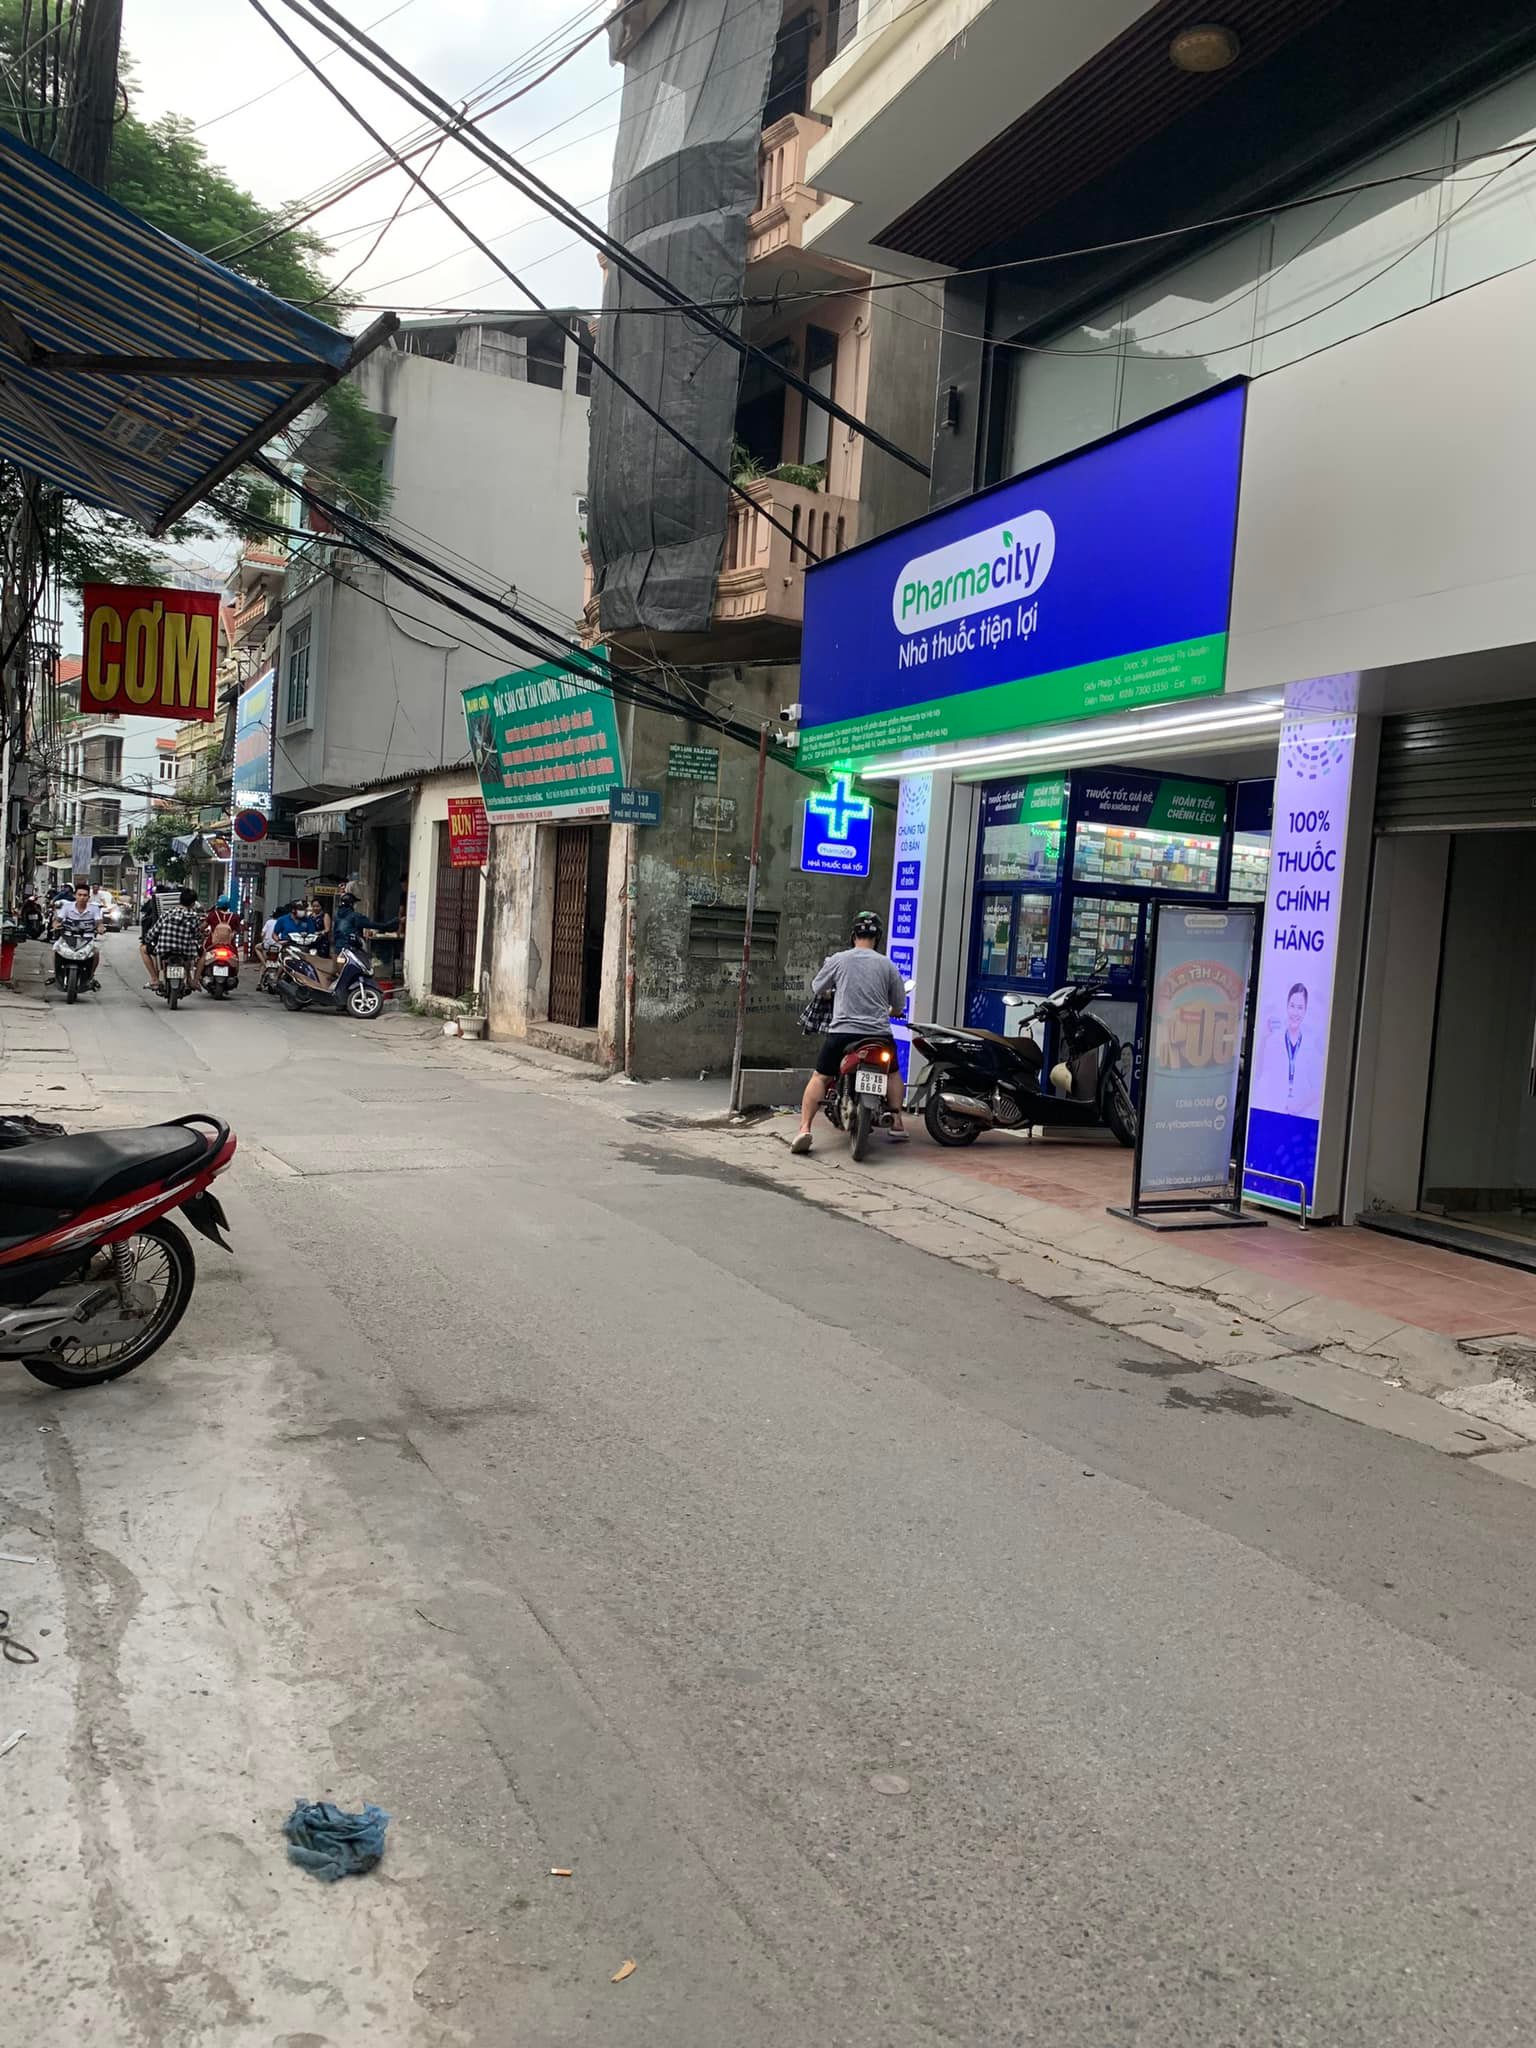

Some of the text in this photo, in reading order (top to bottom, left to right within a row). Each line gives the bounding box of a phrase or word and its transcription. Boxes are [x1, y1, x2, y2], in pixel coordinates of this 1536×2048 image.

[902, 532, 1041, 620] Pharmacity
[899, 601, 1038, 670] Nhà thuốc tiện lợi
[87, 601, 213, 709] CƠM
[1086, 787, 1111, 799] THUỐC
[1289, 810, 1330, 833] 100%
[908, 840, 921, 851] BÁN
[1277, 840, 1337, 872] THUỐC
[821, 860, 841, 869] THUỐC
[1276, 885, 1330, 911] CHÍNH
[1274, 925, 1324, 951] HÃNG
